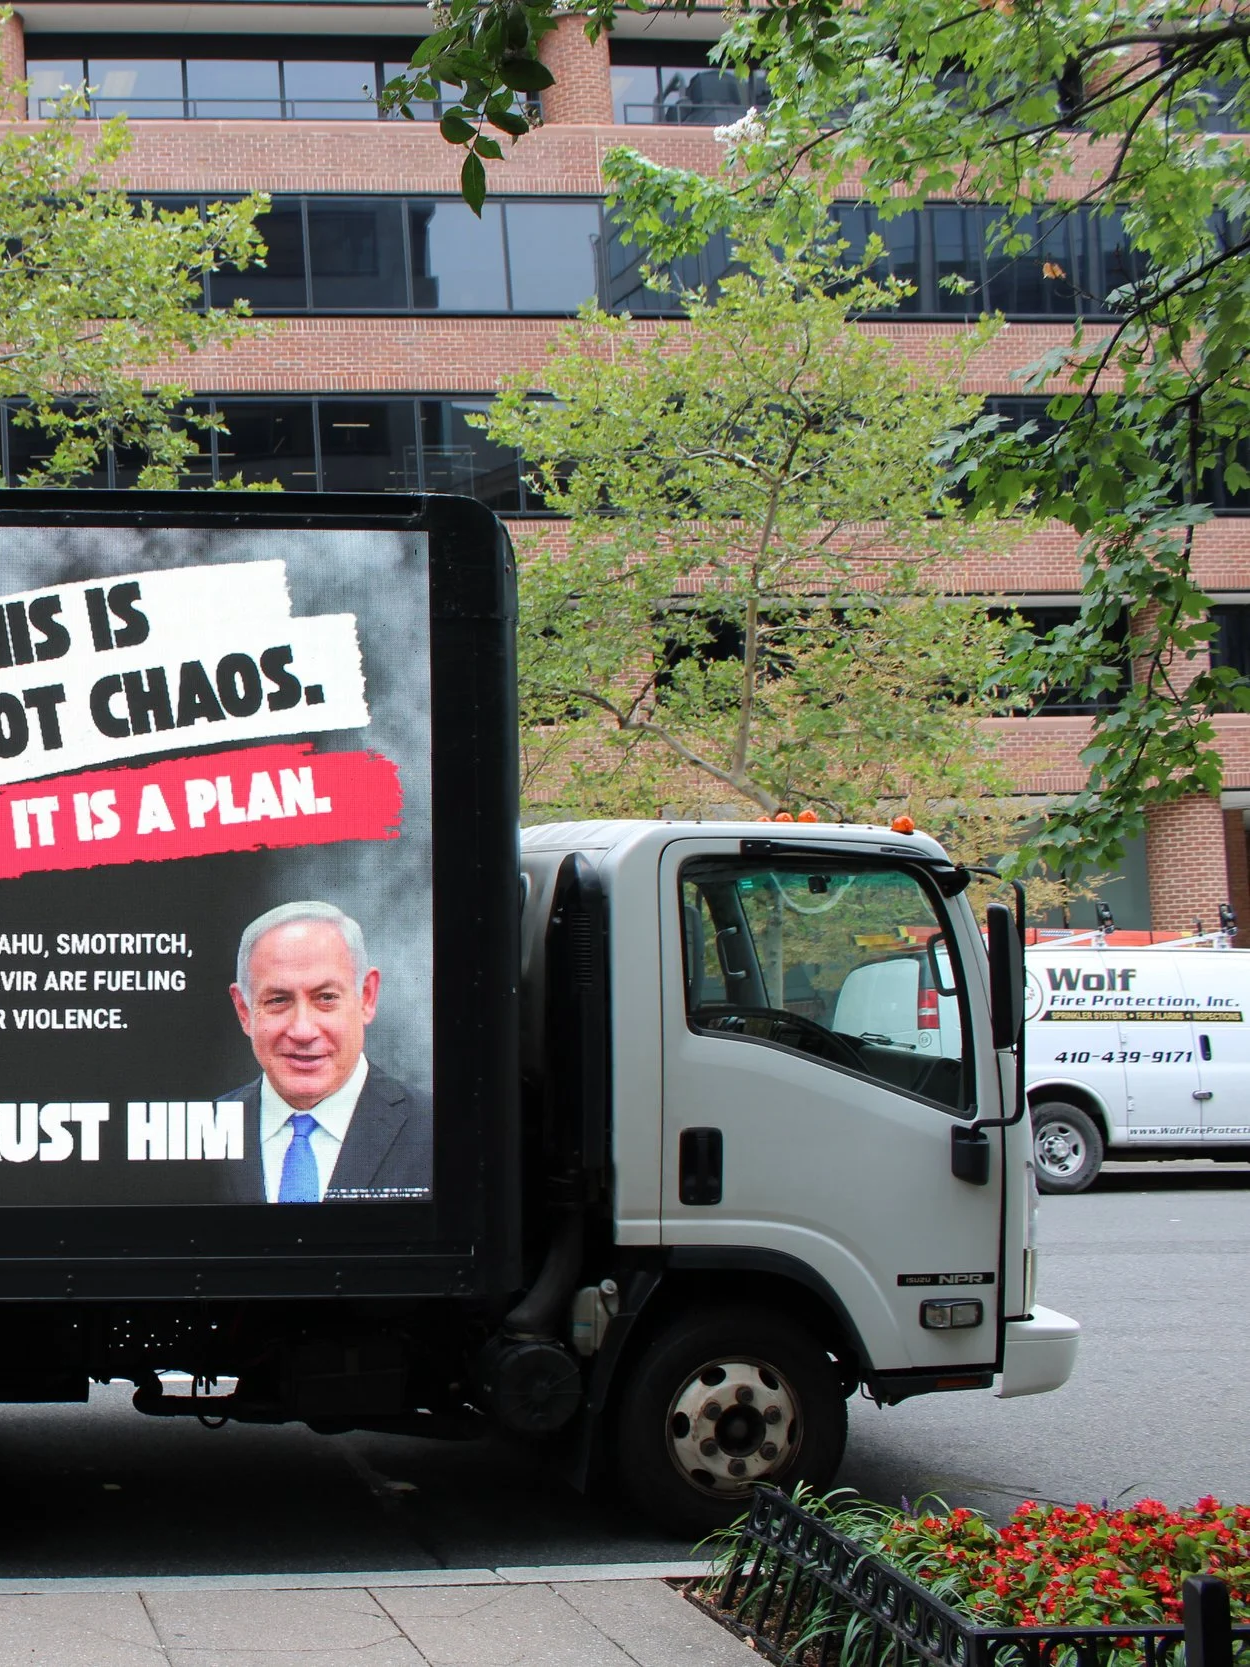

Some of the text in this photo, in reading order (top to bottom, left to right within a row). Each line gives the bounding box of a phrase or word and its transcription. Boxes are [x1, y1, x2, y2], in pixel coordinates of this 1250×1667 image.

[85, 581, 150, 652] IS
[90, 644, 325, 738] CHAOS.
[10, 766, 332, 849] IT IS A PLAN.
[56, 933, 193, 958] SMOTRITCH,
[43, 971, 87, 992] ARE
[93, 970, 186, 991] FUELING
[1045, 968, 1136, 991] Wolf
[1050, 995, 1240, 1008] Fire Protection, Inc.
[12, 1008, 128, 1029] VIOLENCE.
[1051, 1011, 1240, 1020] SPRINKLER SYSTEMS FIRE ALARMS INSPECTIONS
[1054, 1051, 1193, 1063] 410-439-9171
[127, 1101, 244, 1161] HIM
[938, 1274, 983, 1284] NPR
